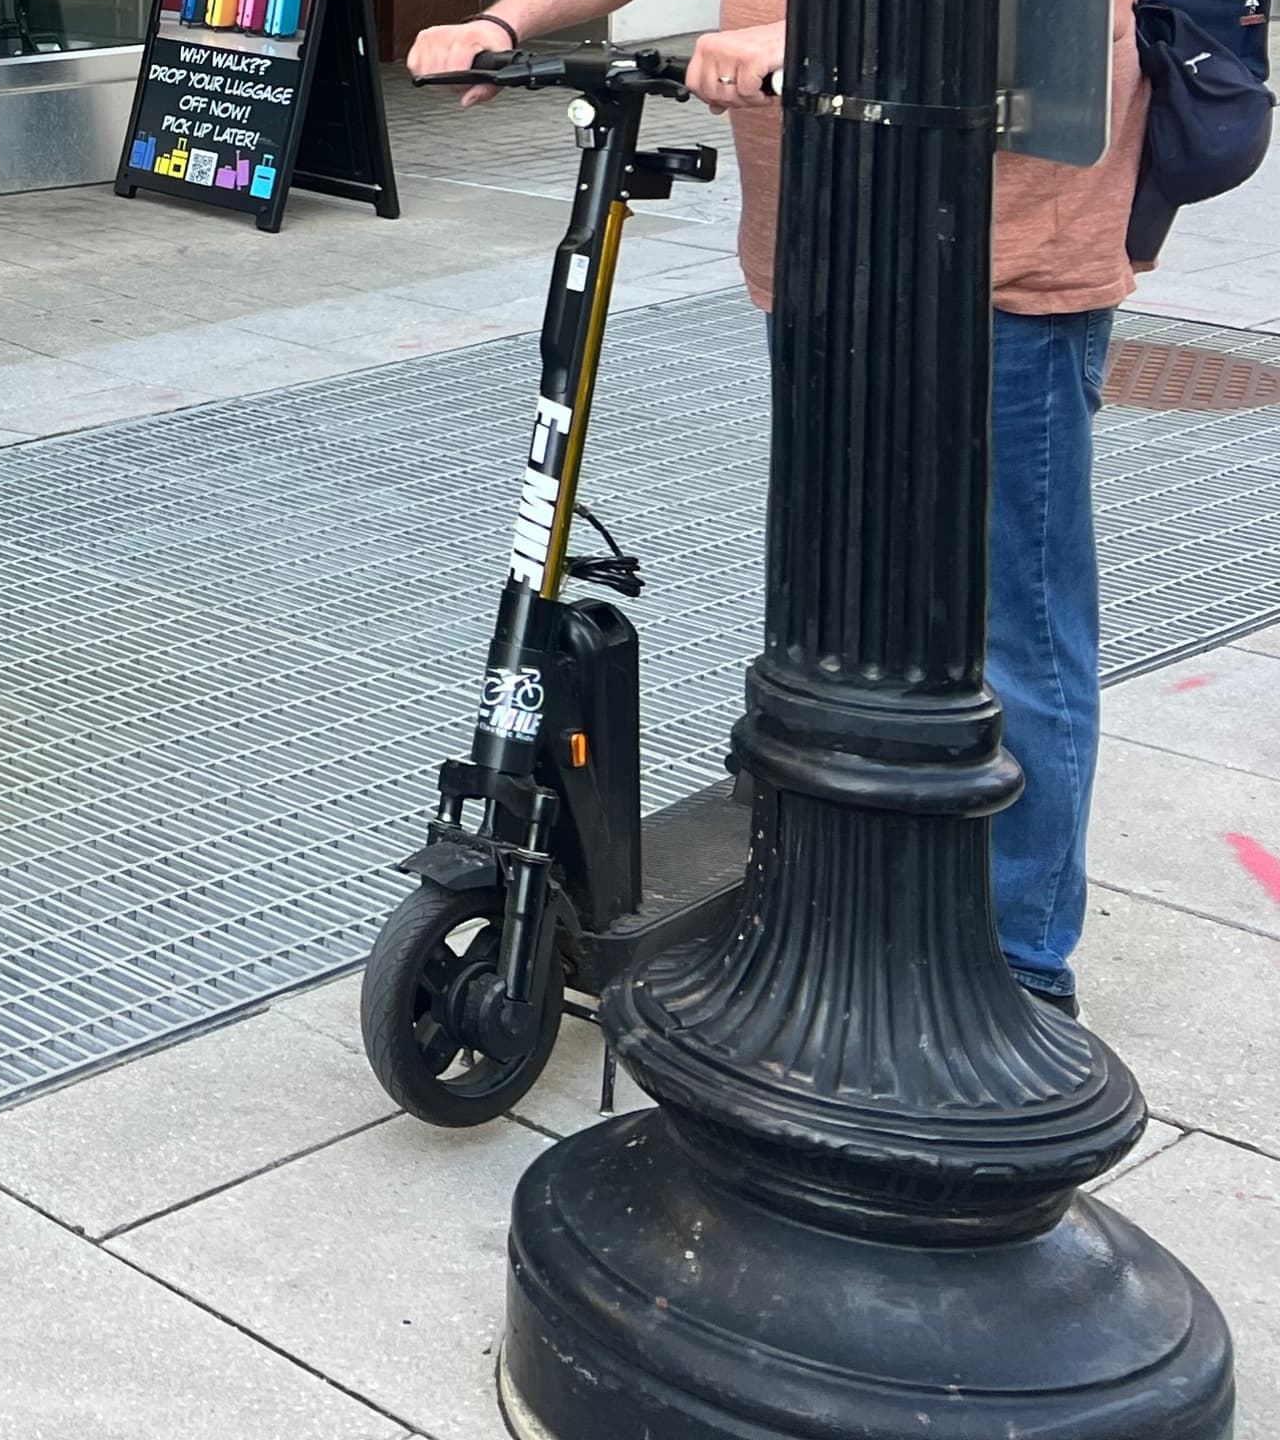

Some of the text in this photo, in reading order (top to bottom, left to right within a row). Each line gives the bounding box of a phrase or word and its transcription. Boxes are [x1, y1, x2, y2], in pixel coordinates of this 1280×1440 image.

[179, 45, 272, 76] WHY WALK??
[148, 64, 295, 106] DROP YOUR LUGGAGE
[179, 95, 252, 125] OFF NOW!
[161, 115, 261, 151] PICK UP LATER!
[479, 705, 544, 736] -MILE
